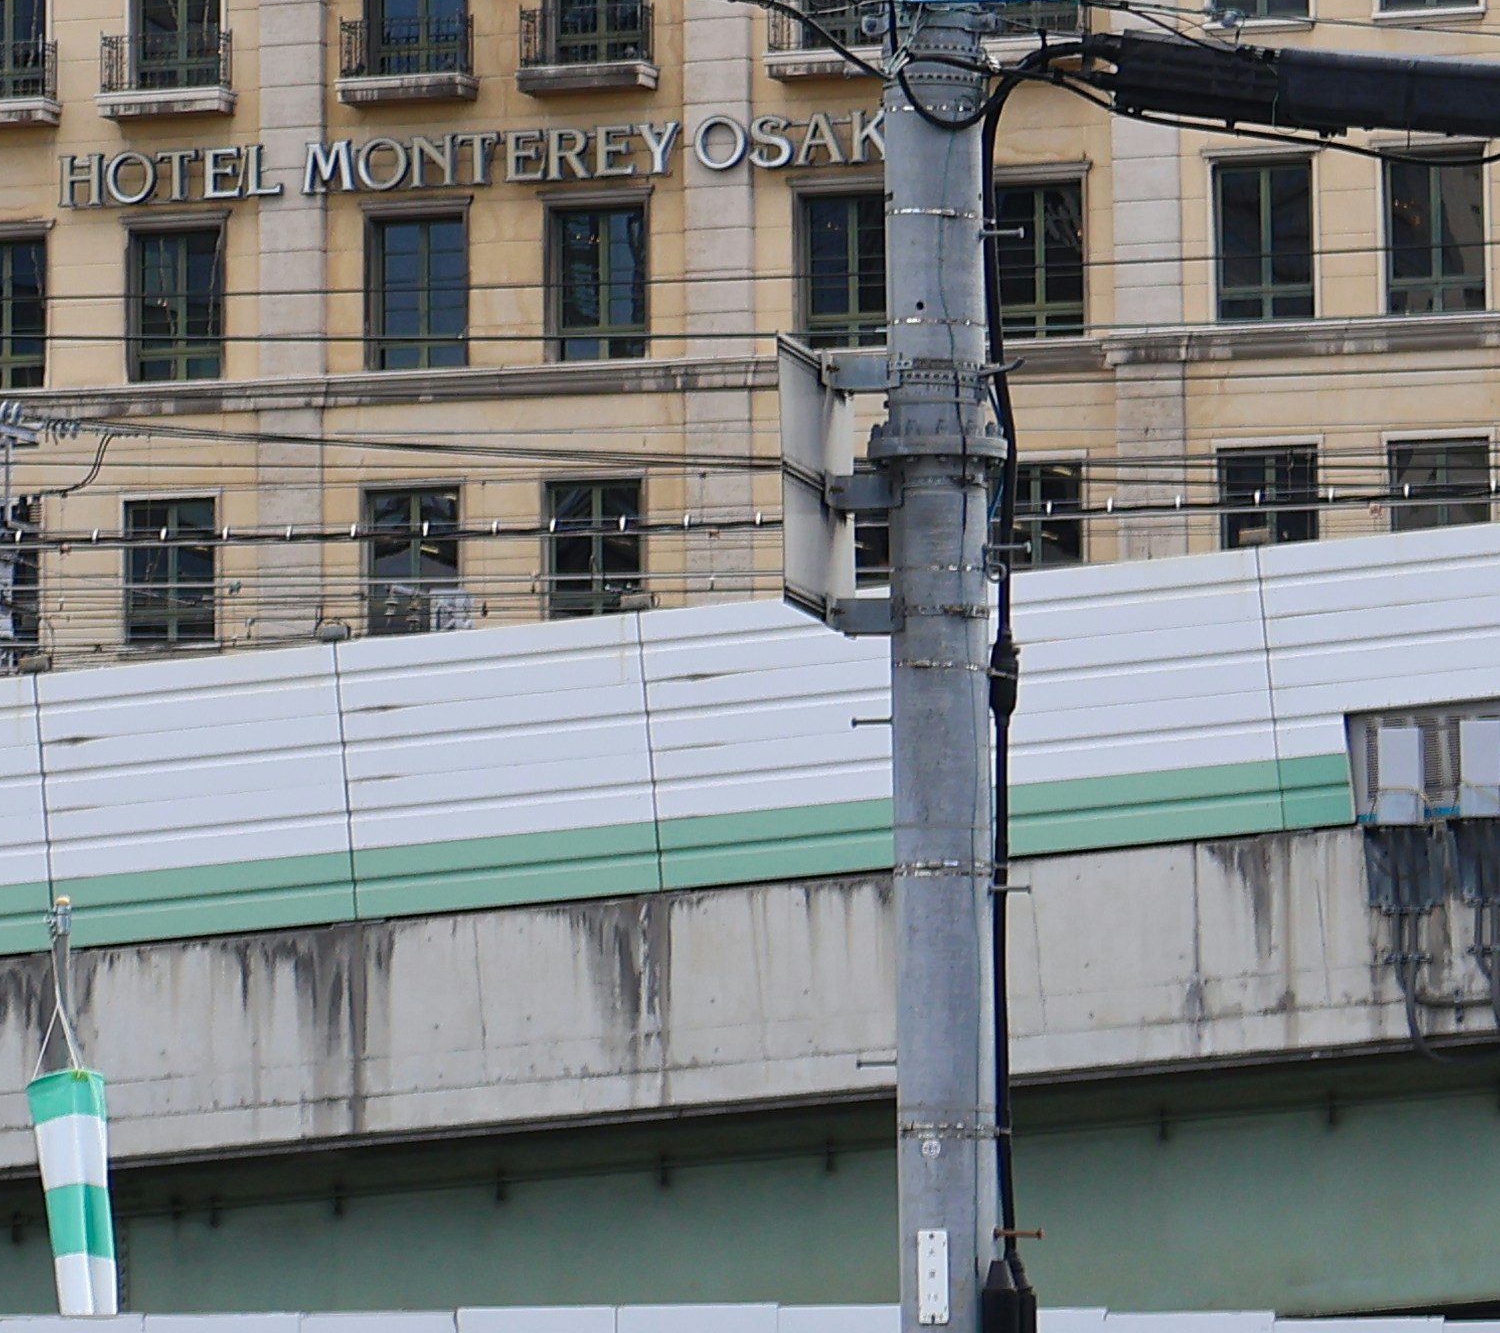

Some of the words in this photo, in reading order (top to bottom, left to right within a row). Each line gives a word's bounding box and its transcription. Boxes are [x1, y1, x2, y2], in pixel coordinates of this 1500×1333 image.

[58, 143, 284, 208] HOTEL
[301, 120, 681, 196] MONTEREY
[693, 107, 886, 171] OSAK
